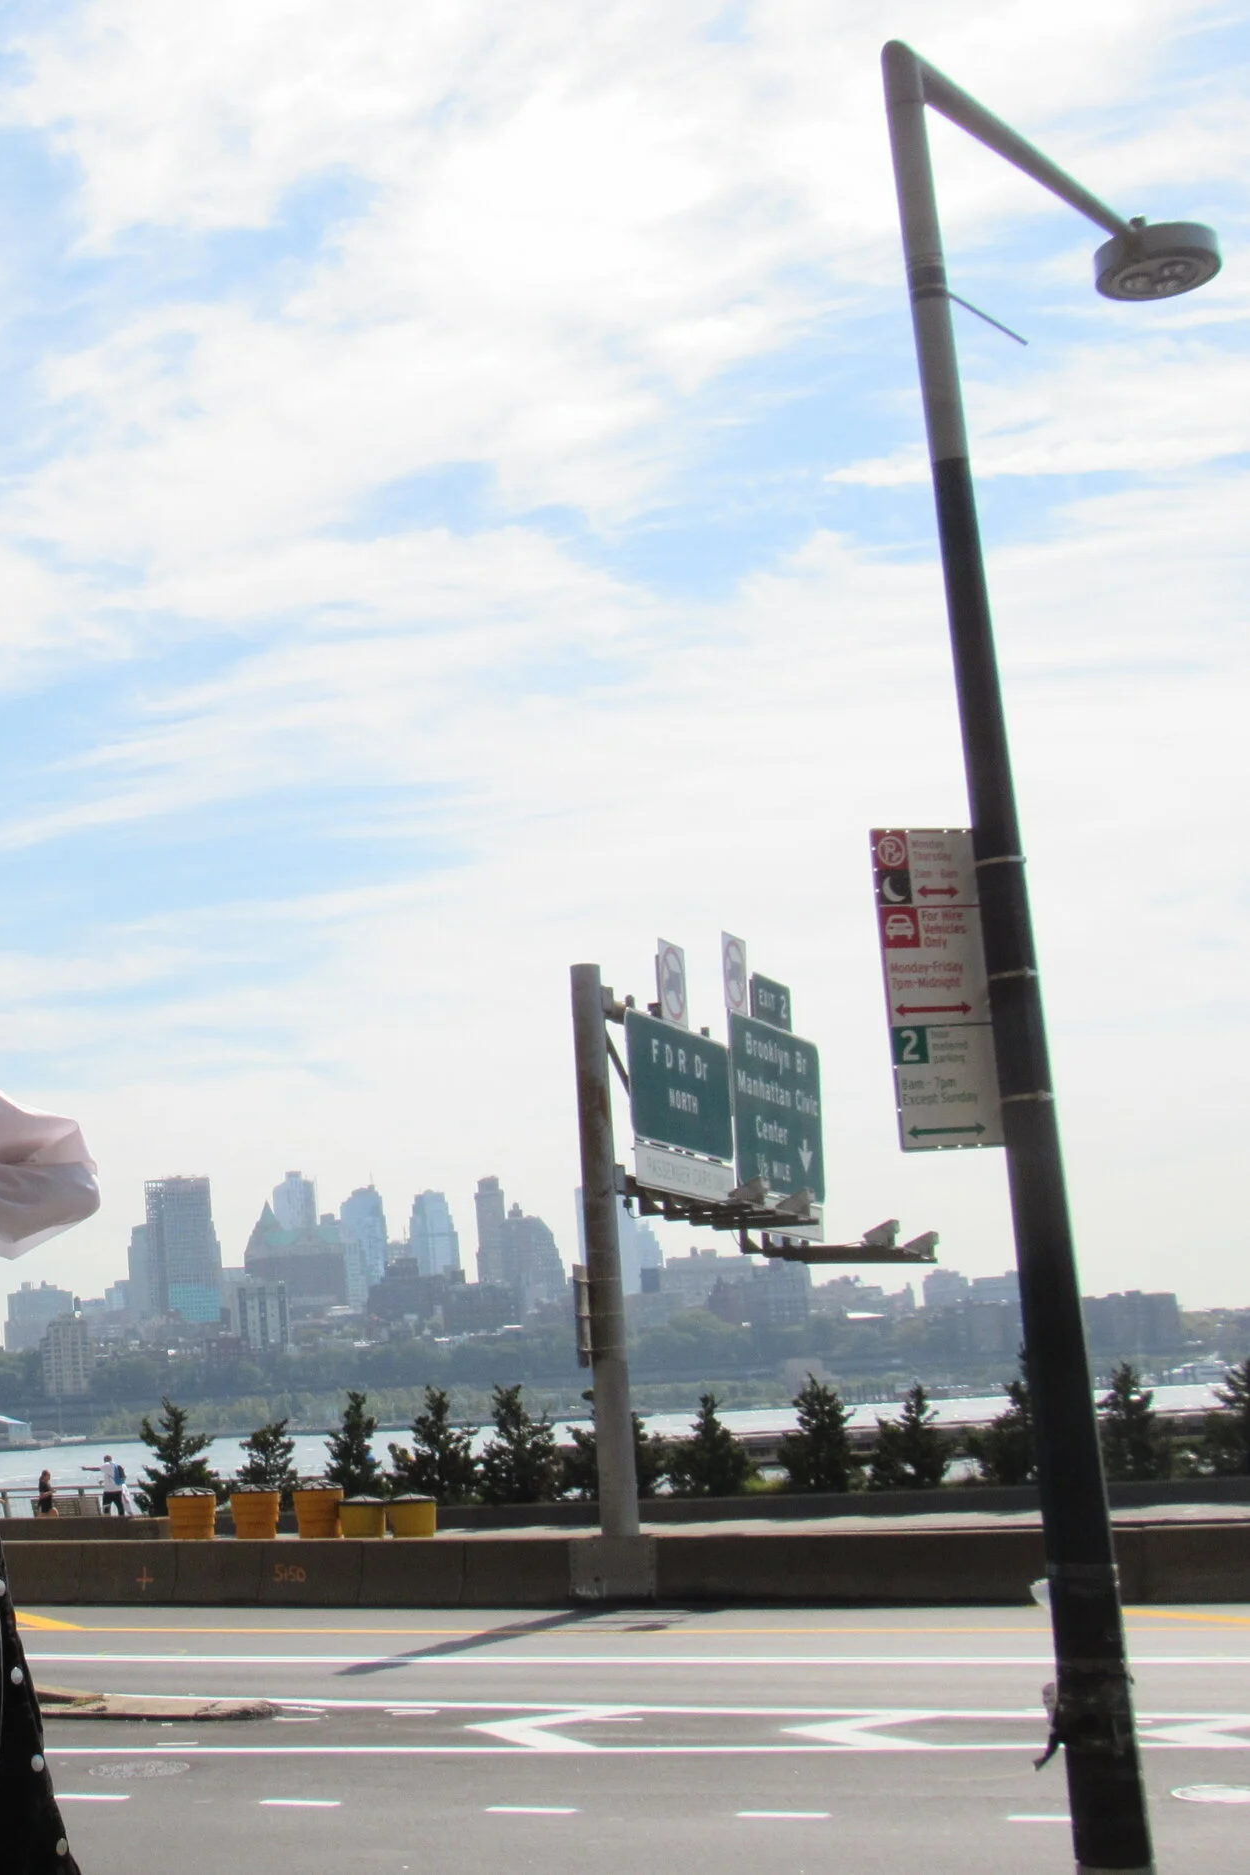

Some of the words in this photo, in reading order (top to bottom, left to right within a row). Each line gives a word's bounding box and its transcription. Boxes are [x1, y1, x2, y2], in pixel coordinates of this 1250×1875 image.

[922, 911, 938, 921] For
[942, 910, 964, 921] Hire
[924, 924, 968, 935] Vehicles
[925, 936, 948, 949] Only
[891, 961, 963, 975] Monday-Friday
[758, 988, 775, 1011] EXIT
[779, 994, 787, 1019] 2
[745, 1031, 790, 1075] Brooklyn
[795, 1051, 806, 1074] Br
[901, 1030, 920, 1061] 2
[694, 1053, 708, 1080] Dr
[669, 1087, 698, 1114] NORTH
[737, 1068, 791, 1108] Manhattan
[795, 1089, 818, 1117] Civic
[903, 1093, 938, 1106] Except
[941, 1091, 978, 1104] Sunday
[756, 1115, 787, 1145] Center
